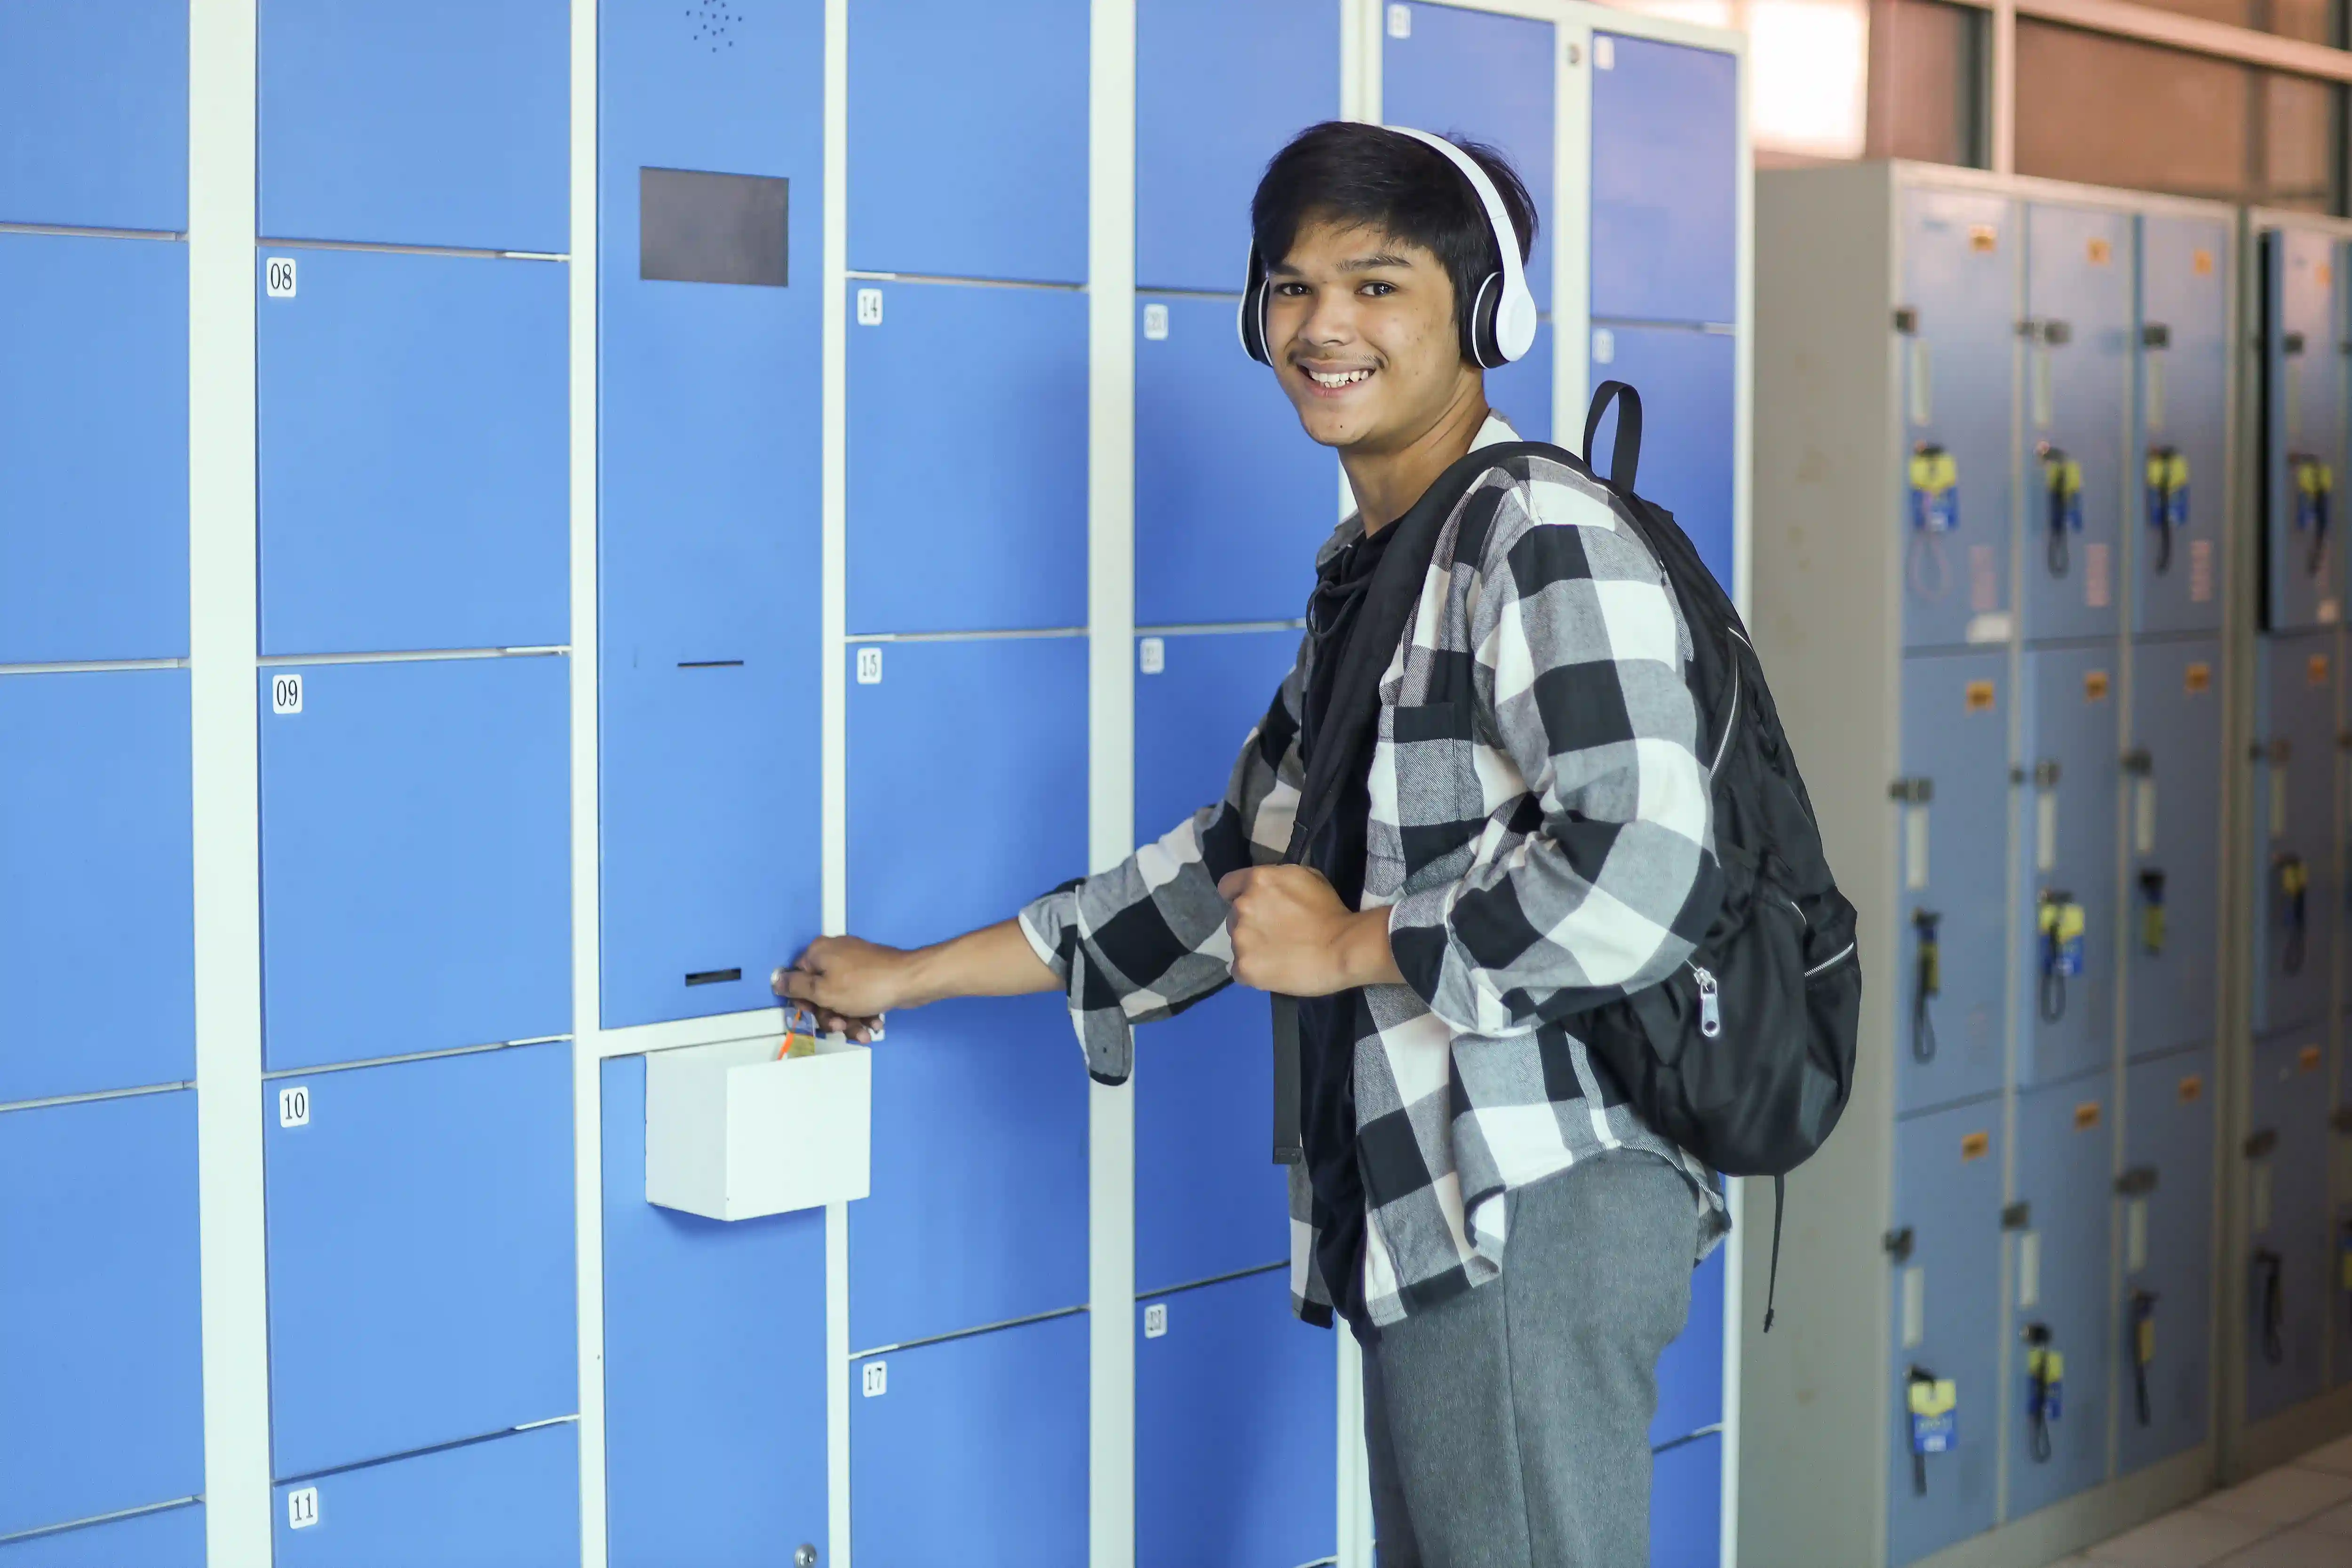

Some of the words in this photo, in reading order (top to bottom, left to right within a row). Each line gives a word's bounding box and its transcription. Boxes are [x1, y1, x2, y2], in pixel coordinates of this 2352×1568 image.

[270, 262, 292, 290] 08
[862, 295, 878, 318] 14
[862, 654, 877, 677] 15
[276, 680, 298, 706] 09
[285, 1092, 305, 1119] 10
[867, 1367, 882, 1391] 17
[294, 1492, 314, 1521] 11
